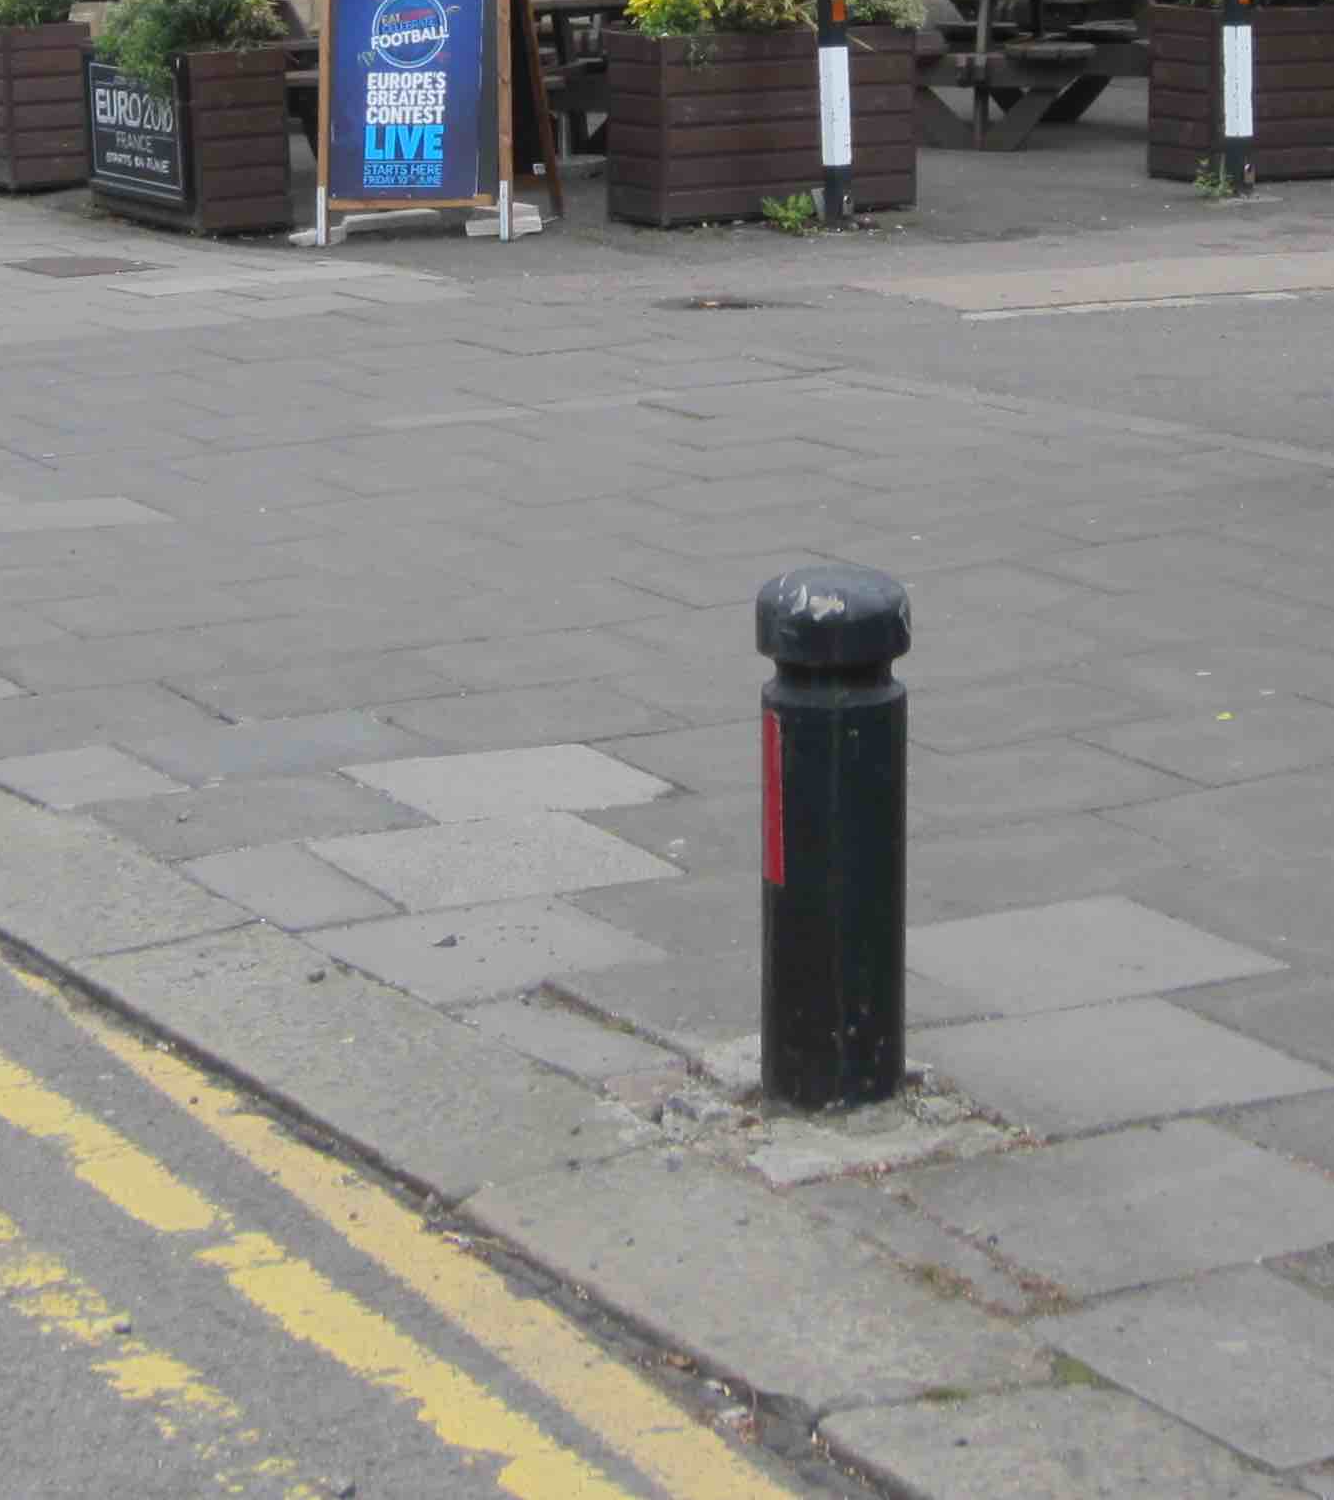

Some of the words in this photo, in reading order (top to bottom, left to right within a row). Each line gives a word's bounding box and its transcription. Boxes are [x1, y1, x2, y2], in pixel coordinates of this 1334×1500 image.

[370, 25, 449, 50] FOOTBALL
[366, 71, 446, 90] EUROPE'S
[95, 88, 141, 127] EURO
[366, 90, 445, 106] GREATEST
[366, 106, 445, 125] CONTEST
[365, 124, 444, 160] LIVE
[363, 163, 407, 175] STARTS
[410, 163, 442, 175] HERE
